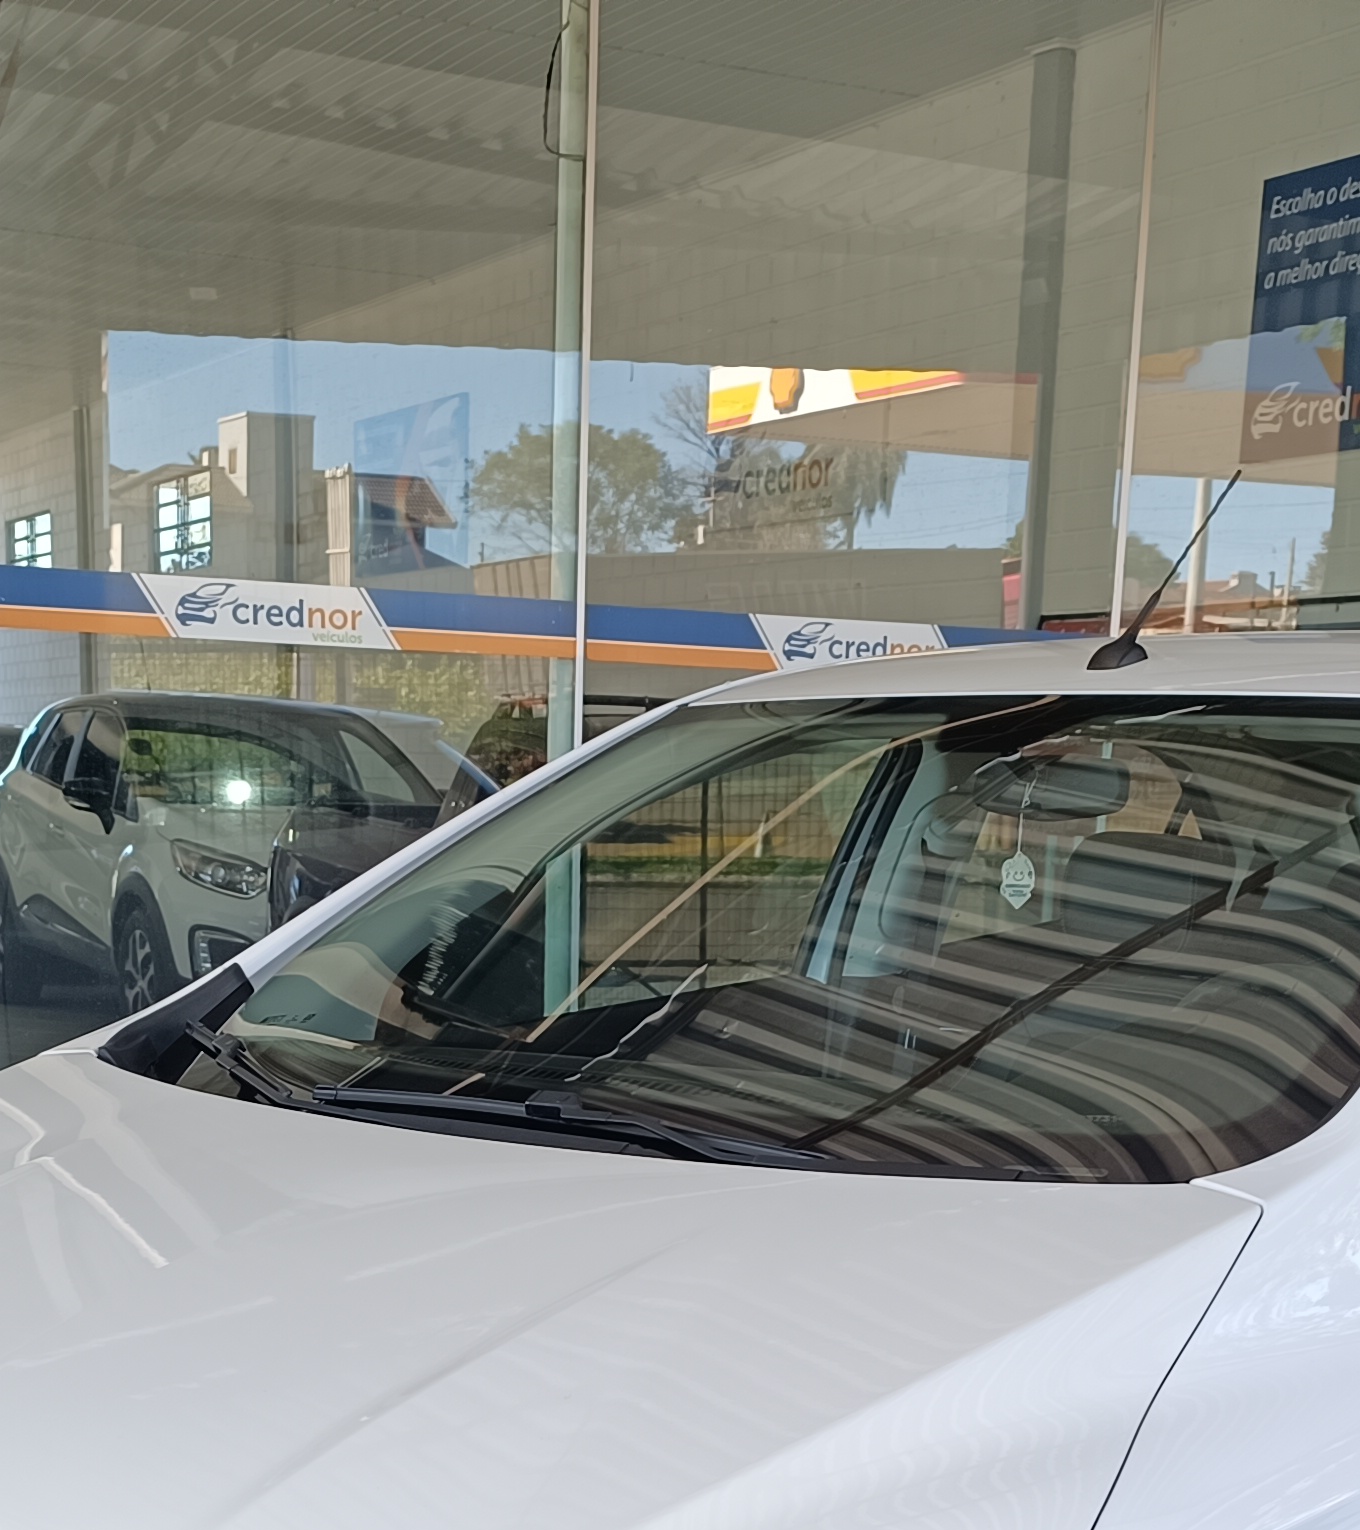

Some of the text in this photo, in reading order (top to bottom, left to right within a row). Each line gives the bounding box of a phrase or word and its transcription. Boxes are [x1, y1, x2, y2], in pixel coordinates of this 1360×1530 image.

[1270, 187, 1325, 219] Escolha
[1326, 187, 1338, 205] o
[1267, 229, 1294, 254] nós
[1264, 272, 1275, 290] a
[1276, 258, 1328, 286] melhor
[232, 598, 363, 631] crednor
[312, 631, 363, 644] veículos
